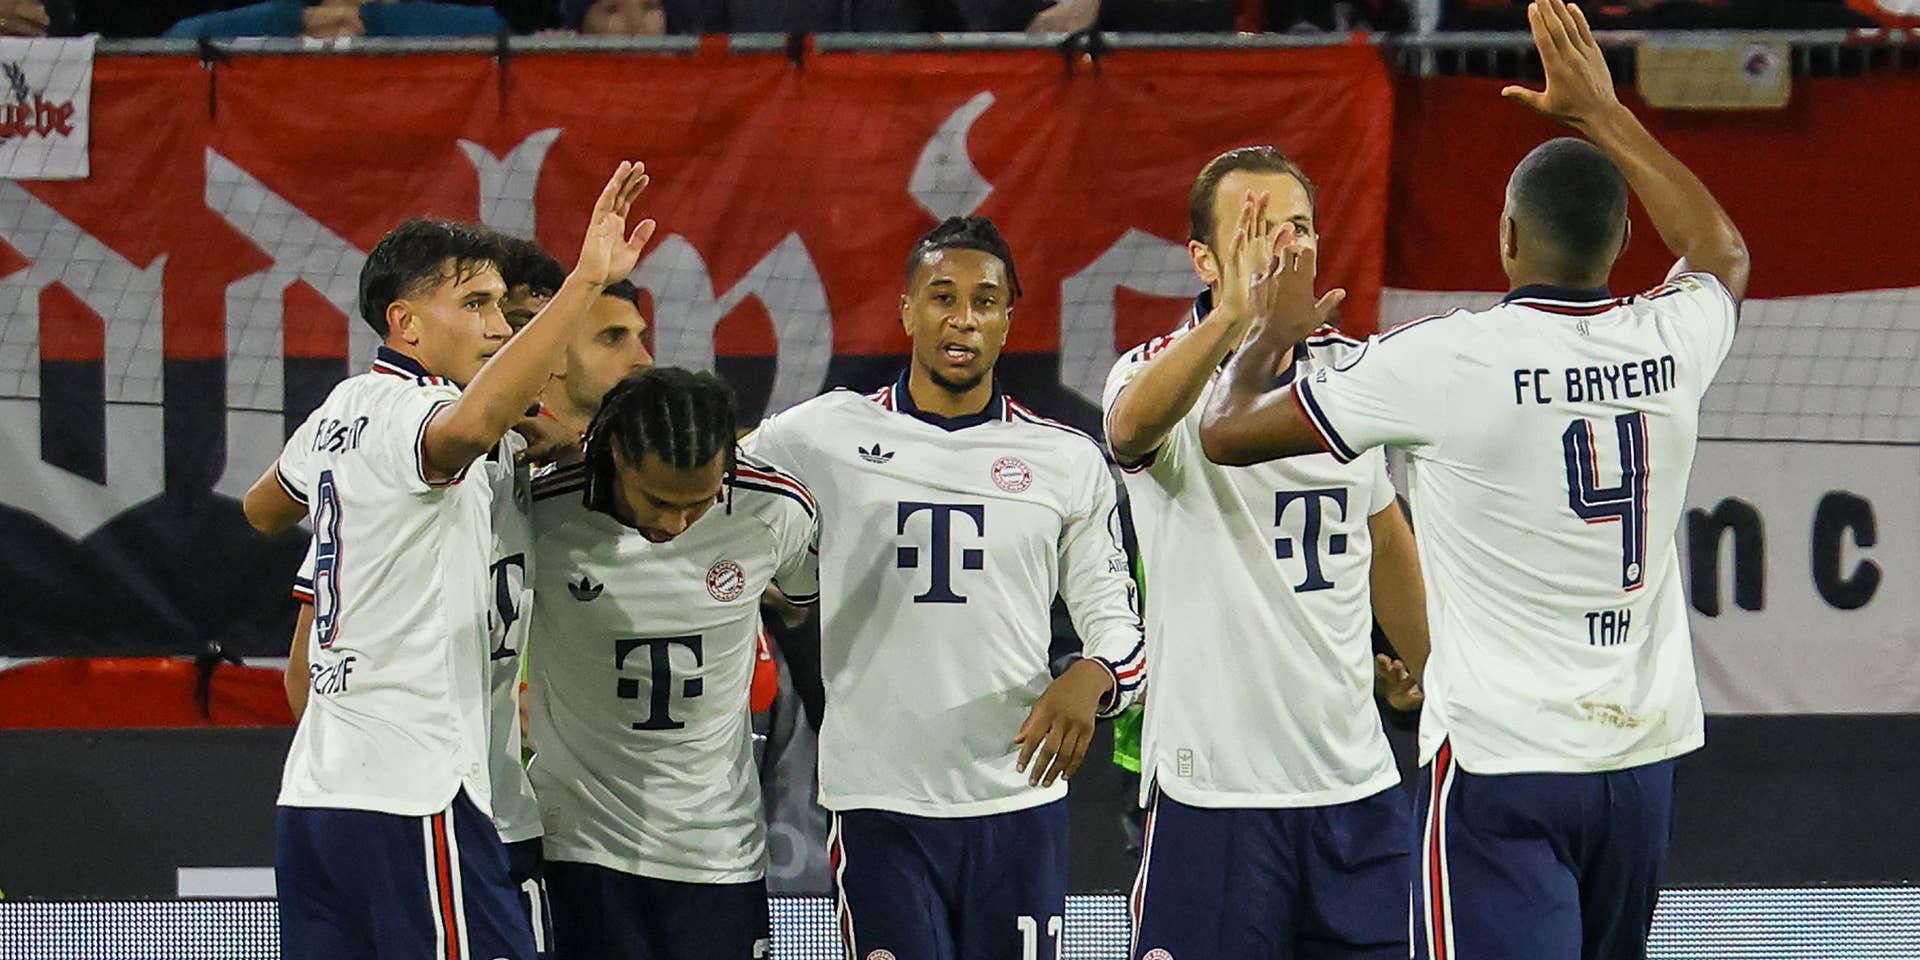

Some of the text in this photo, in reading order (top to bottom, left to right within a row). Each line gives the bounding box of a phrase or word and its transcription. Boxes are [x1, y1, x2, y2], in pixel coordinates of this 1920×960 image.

[1514, 354, 1676, 404] FC BAYERN
[1274, 487, 1348, 593] T
[1562, 411, 1649, 592] 4
[897, 501, 985, 603] T
[1585, 608, 1632, 646] TAH
[615, 634, 704, 731] T
